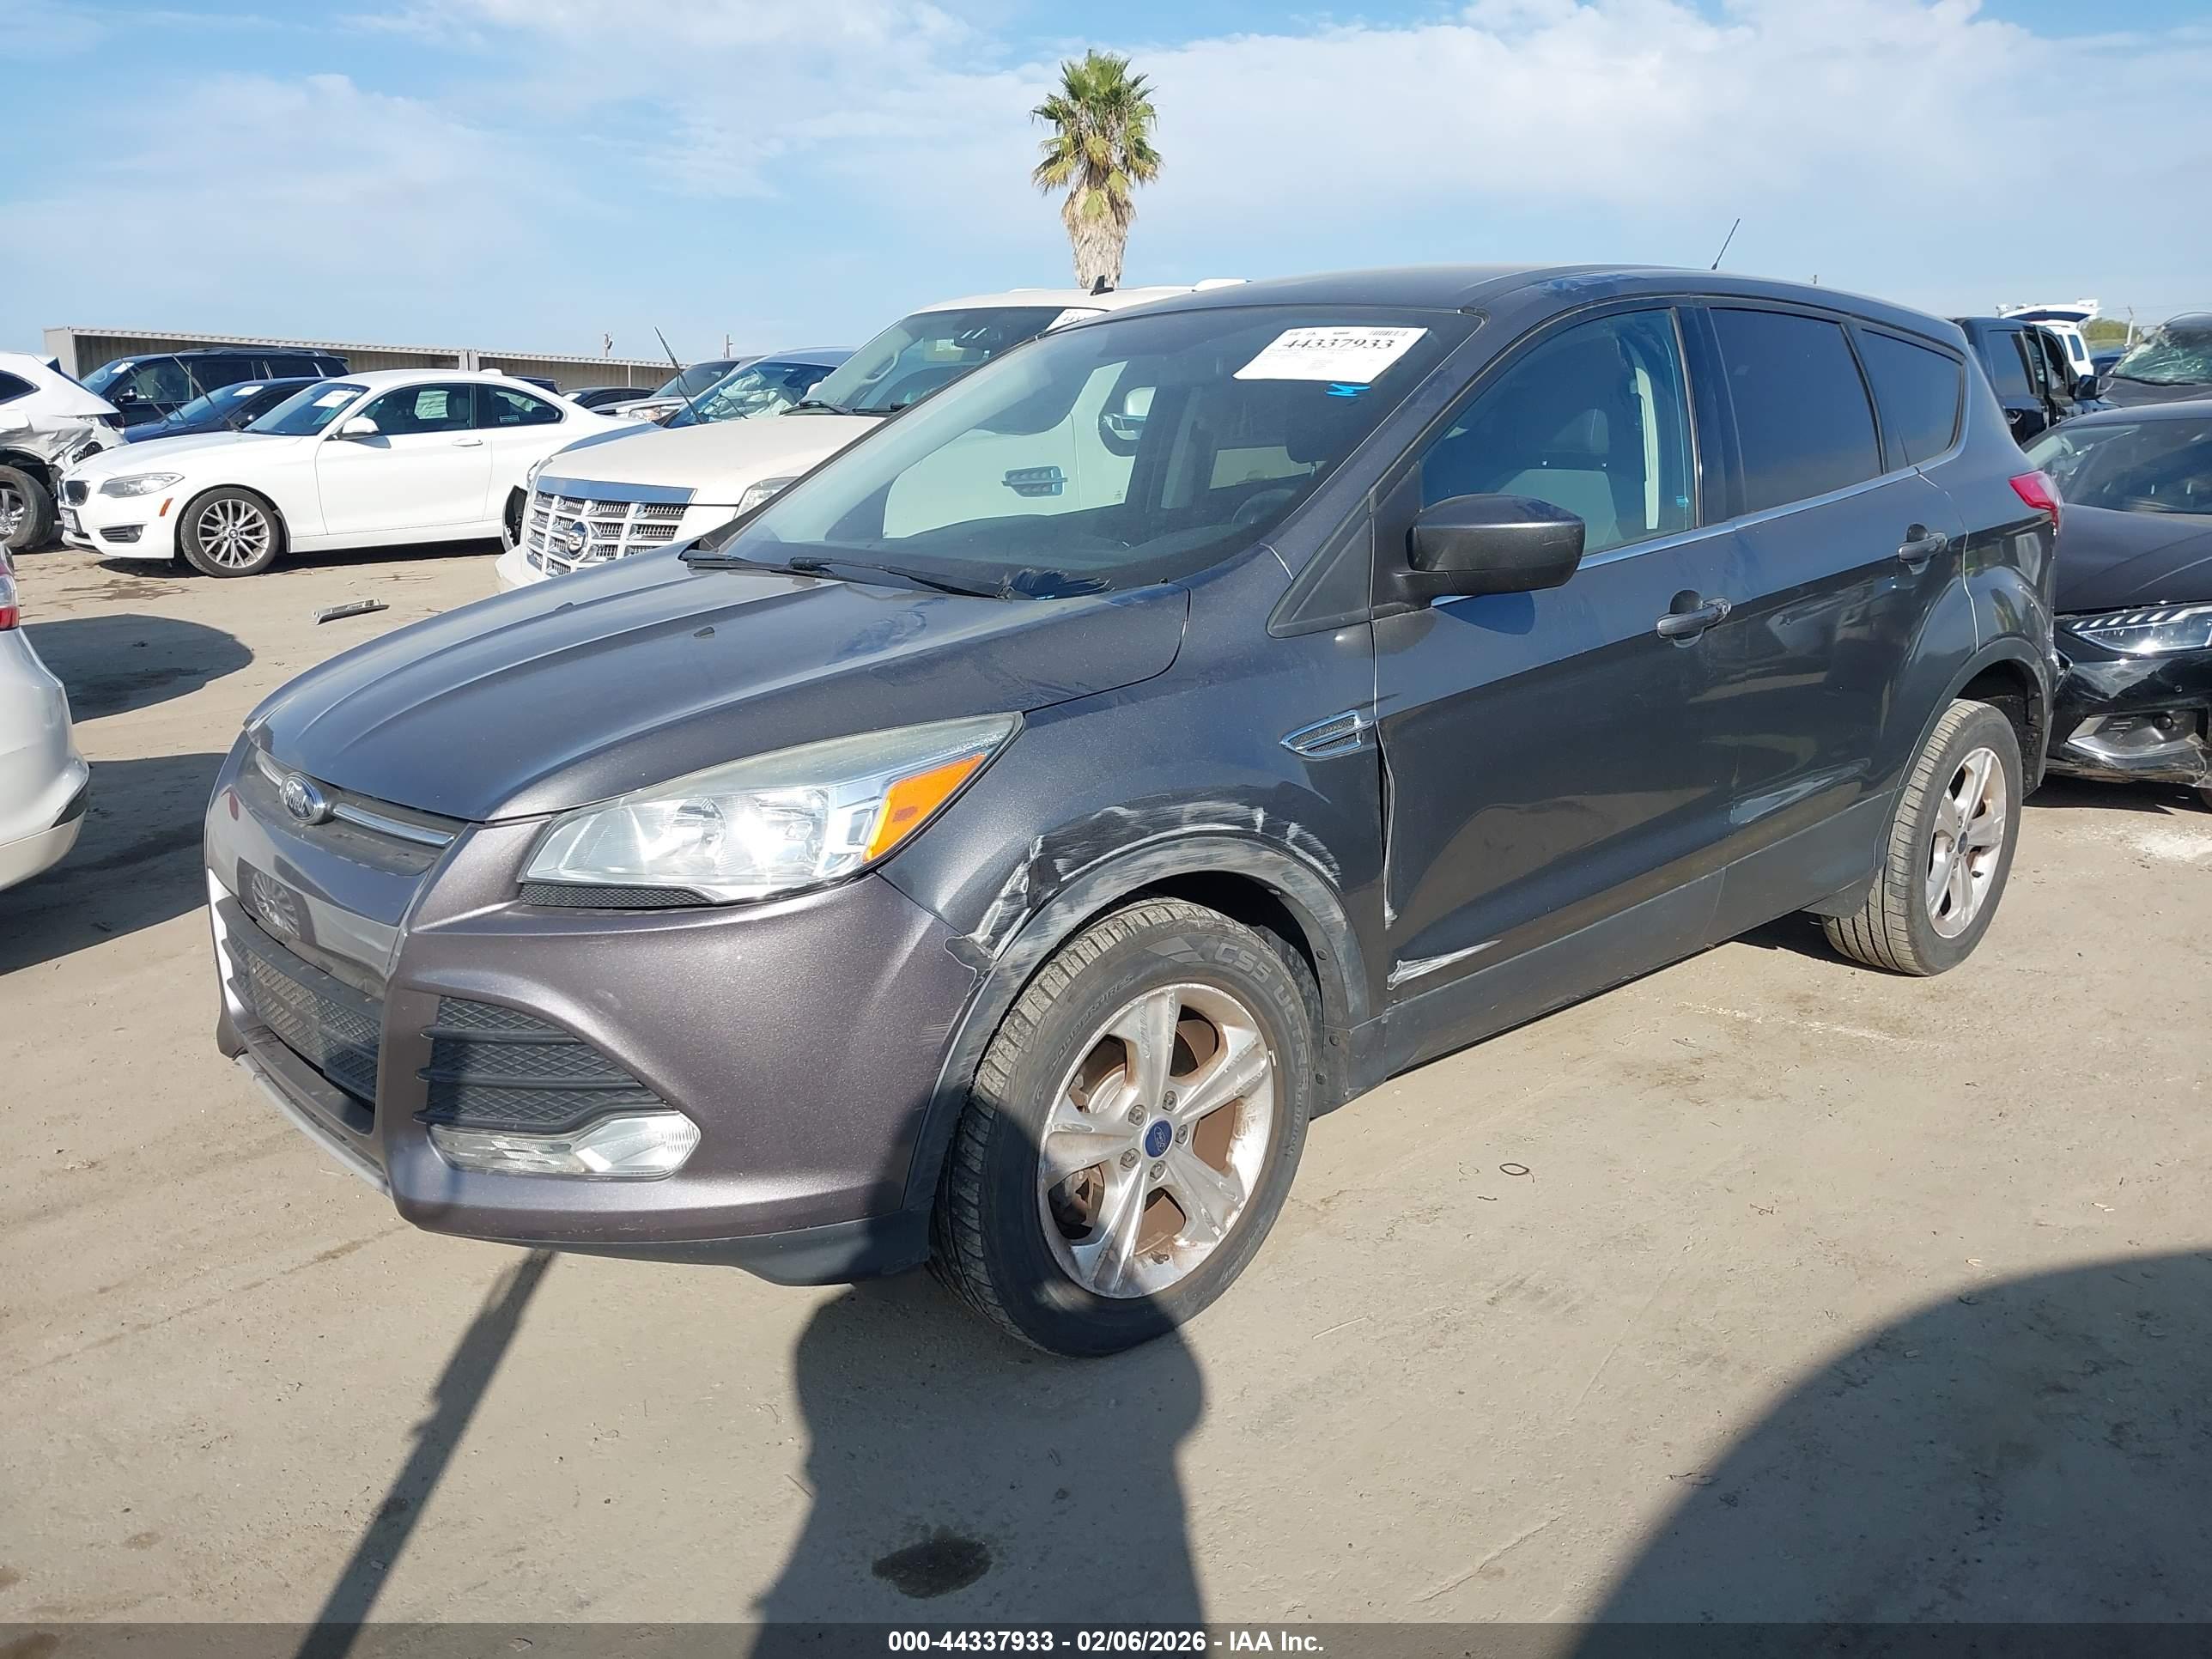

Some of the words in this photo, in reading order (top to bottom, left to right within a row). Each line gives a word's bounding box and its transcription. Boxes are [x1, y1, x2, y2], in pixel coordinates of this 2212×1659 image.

[1282, 337, 1395, 349] 44337933
[284, 781, 307, 814] Ford
[1214, 942, 1273, 984] CS5
[1273, 984, 1310, 1091] ULTRA
